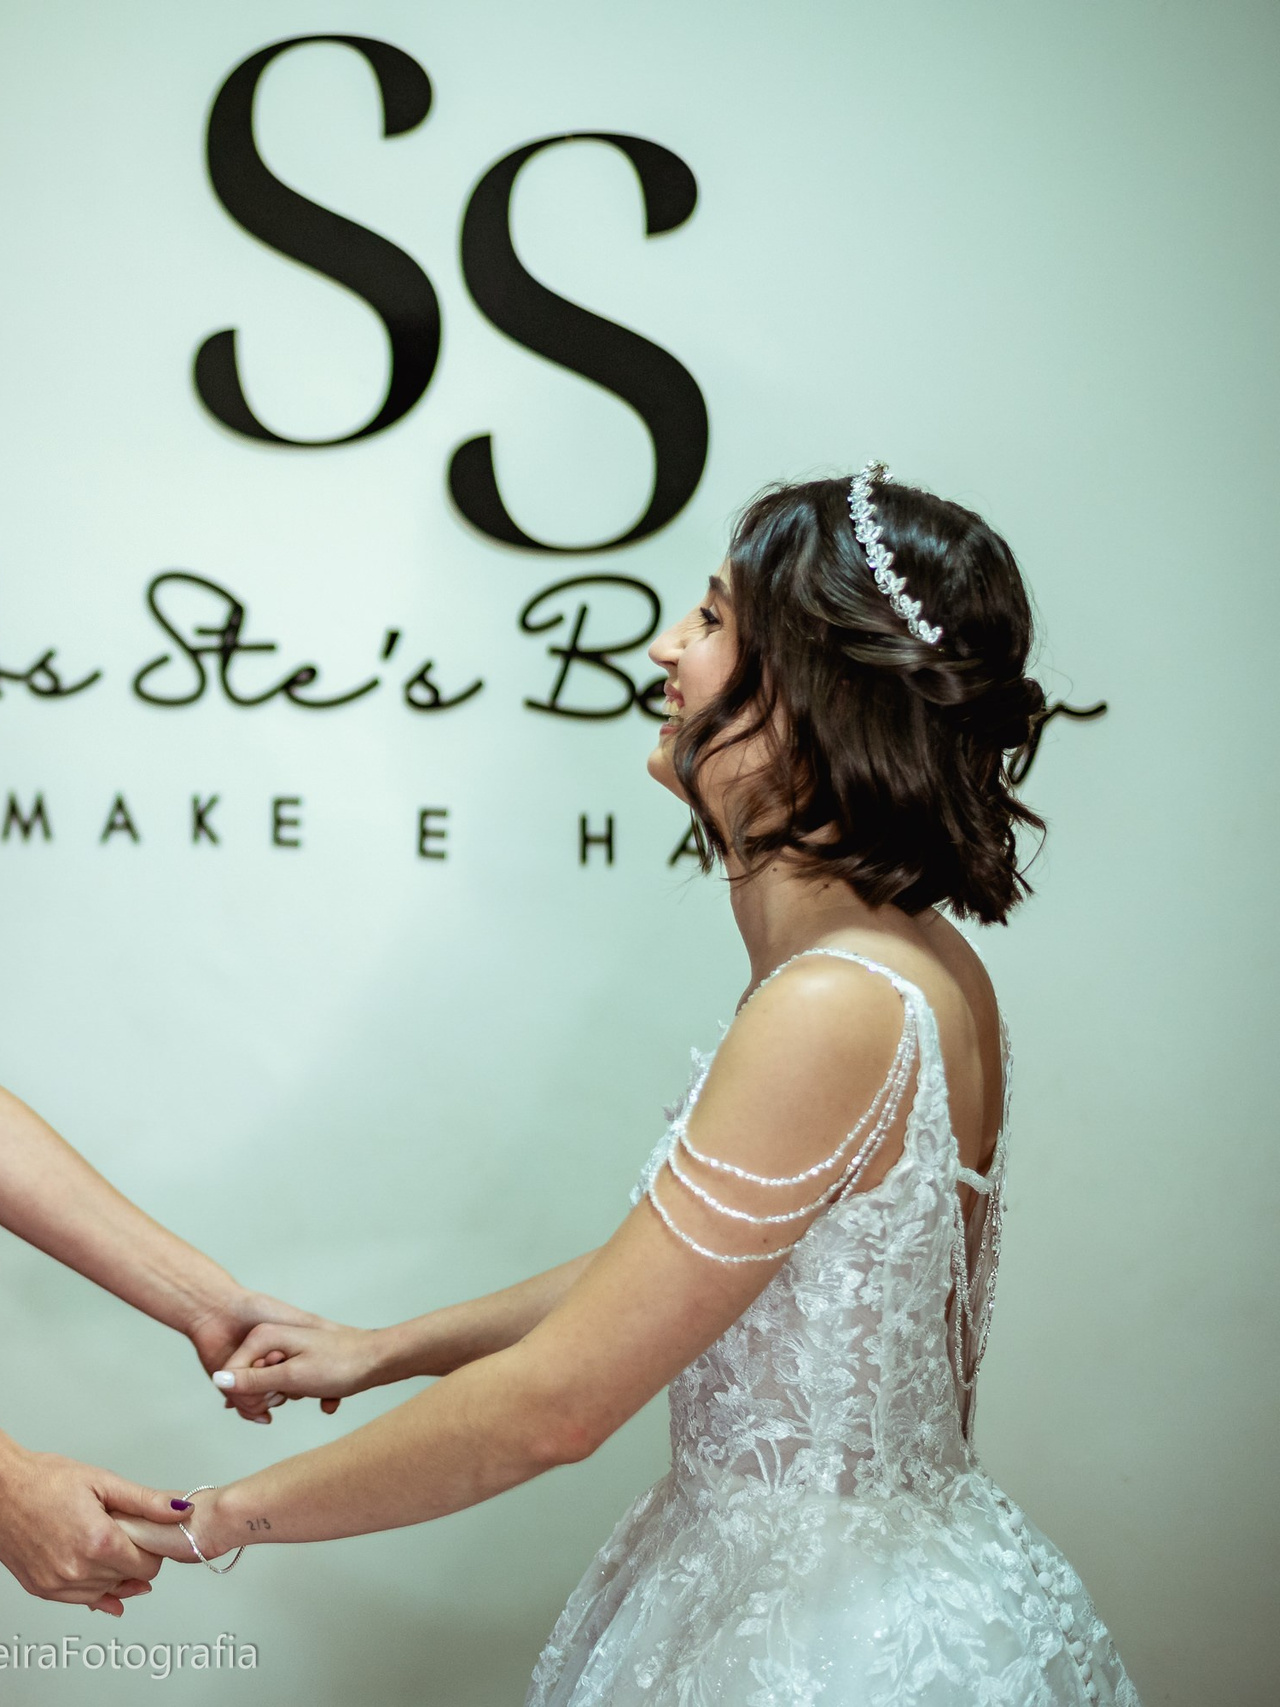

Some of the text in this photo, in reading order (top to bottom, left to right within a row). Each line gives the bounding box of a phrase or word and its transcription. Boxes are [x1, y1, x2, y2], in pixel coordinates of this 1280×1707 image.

[134, 571, 484, 709] Ste's
[2, 792, 304, 848] MAKE
[418, 807, 450, 860] E
